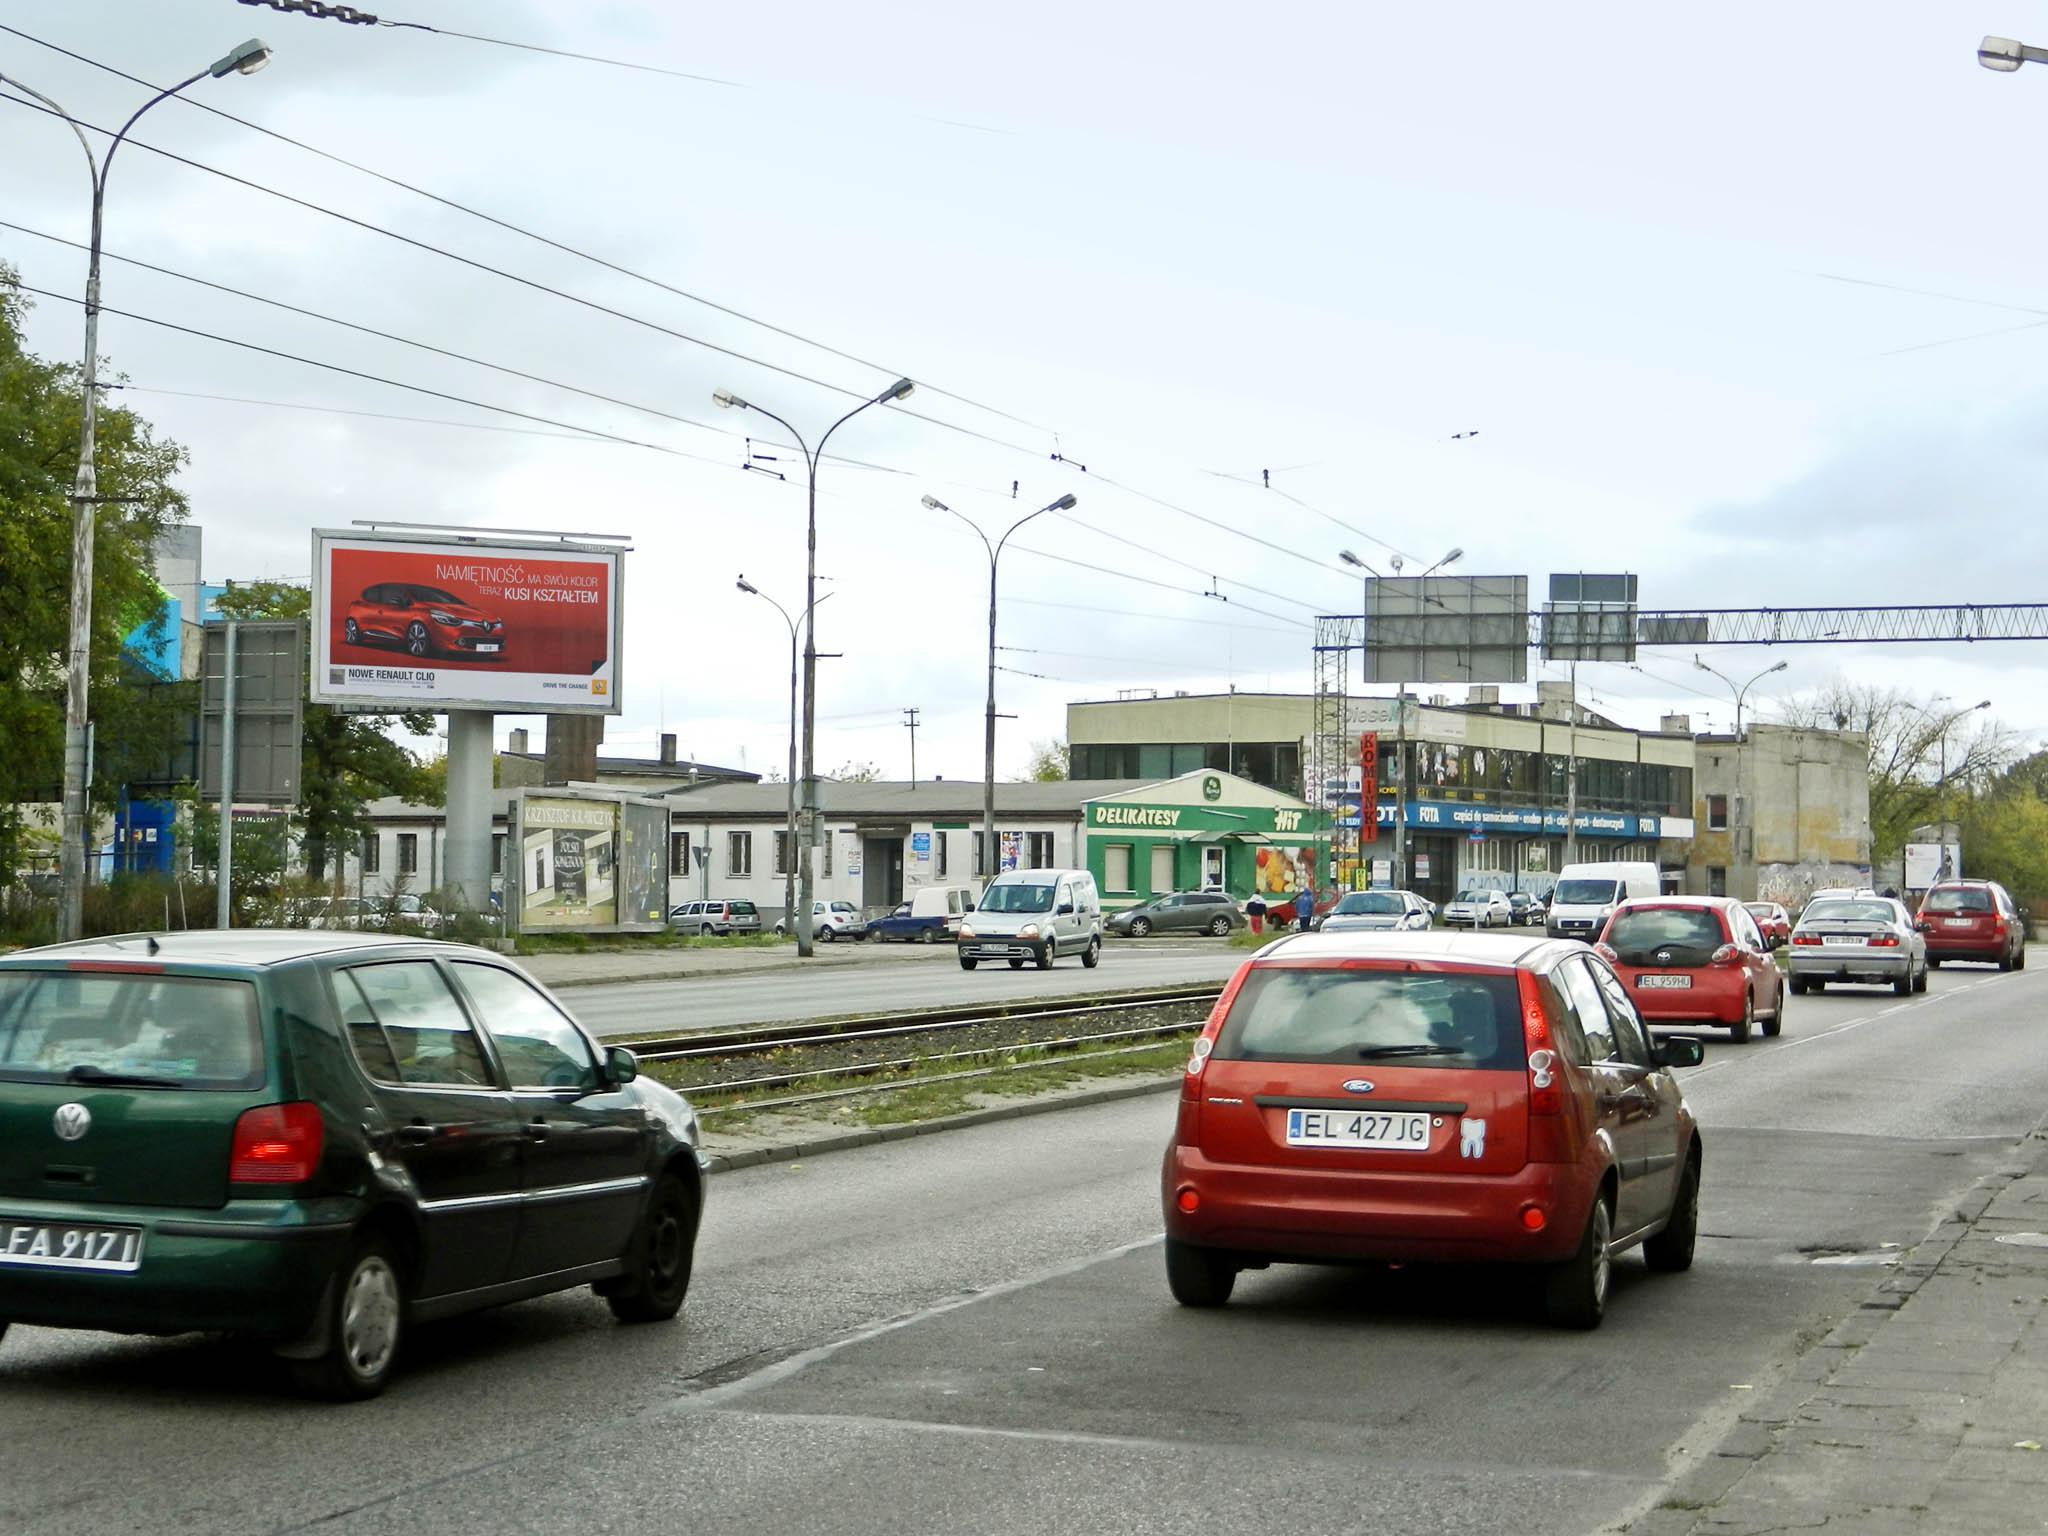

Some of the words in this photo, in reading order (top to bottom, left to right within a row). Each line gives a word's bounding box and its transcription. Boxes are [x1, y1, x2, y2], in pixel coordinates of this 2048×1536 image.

[436, 564, 524, 585] NAMIĘTNOŚĆ
[528, 575, 541, 584] MA
[544, 574, 568, 586] SWÓJ
[570, 576, 598, 588] KOLOR
[479, 586, 501, 596] TERAZ
[504, 587, 530, 601] KUSI
[533, 589, 599, 604] KSZTAŁTEM
[348, 668, 374, 679] NOWE
[376, 669, 414, 681] RENAULT
[415, 671, 435, 681] CLIO
[1363, 734, 1375, 840] KOMINKI
[525, 807, 570, 825] KRZYSZTOF
[1095, 806, 1180, 826] DELIKATESY
[1419, 806, 1440, 823] FOTA
[1639, 818, 1655, 833] FOTA
[1644, 976, 1657, 986] EL
[1304, 1114, 1338, 1138] EL
